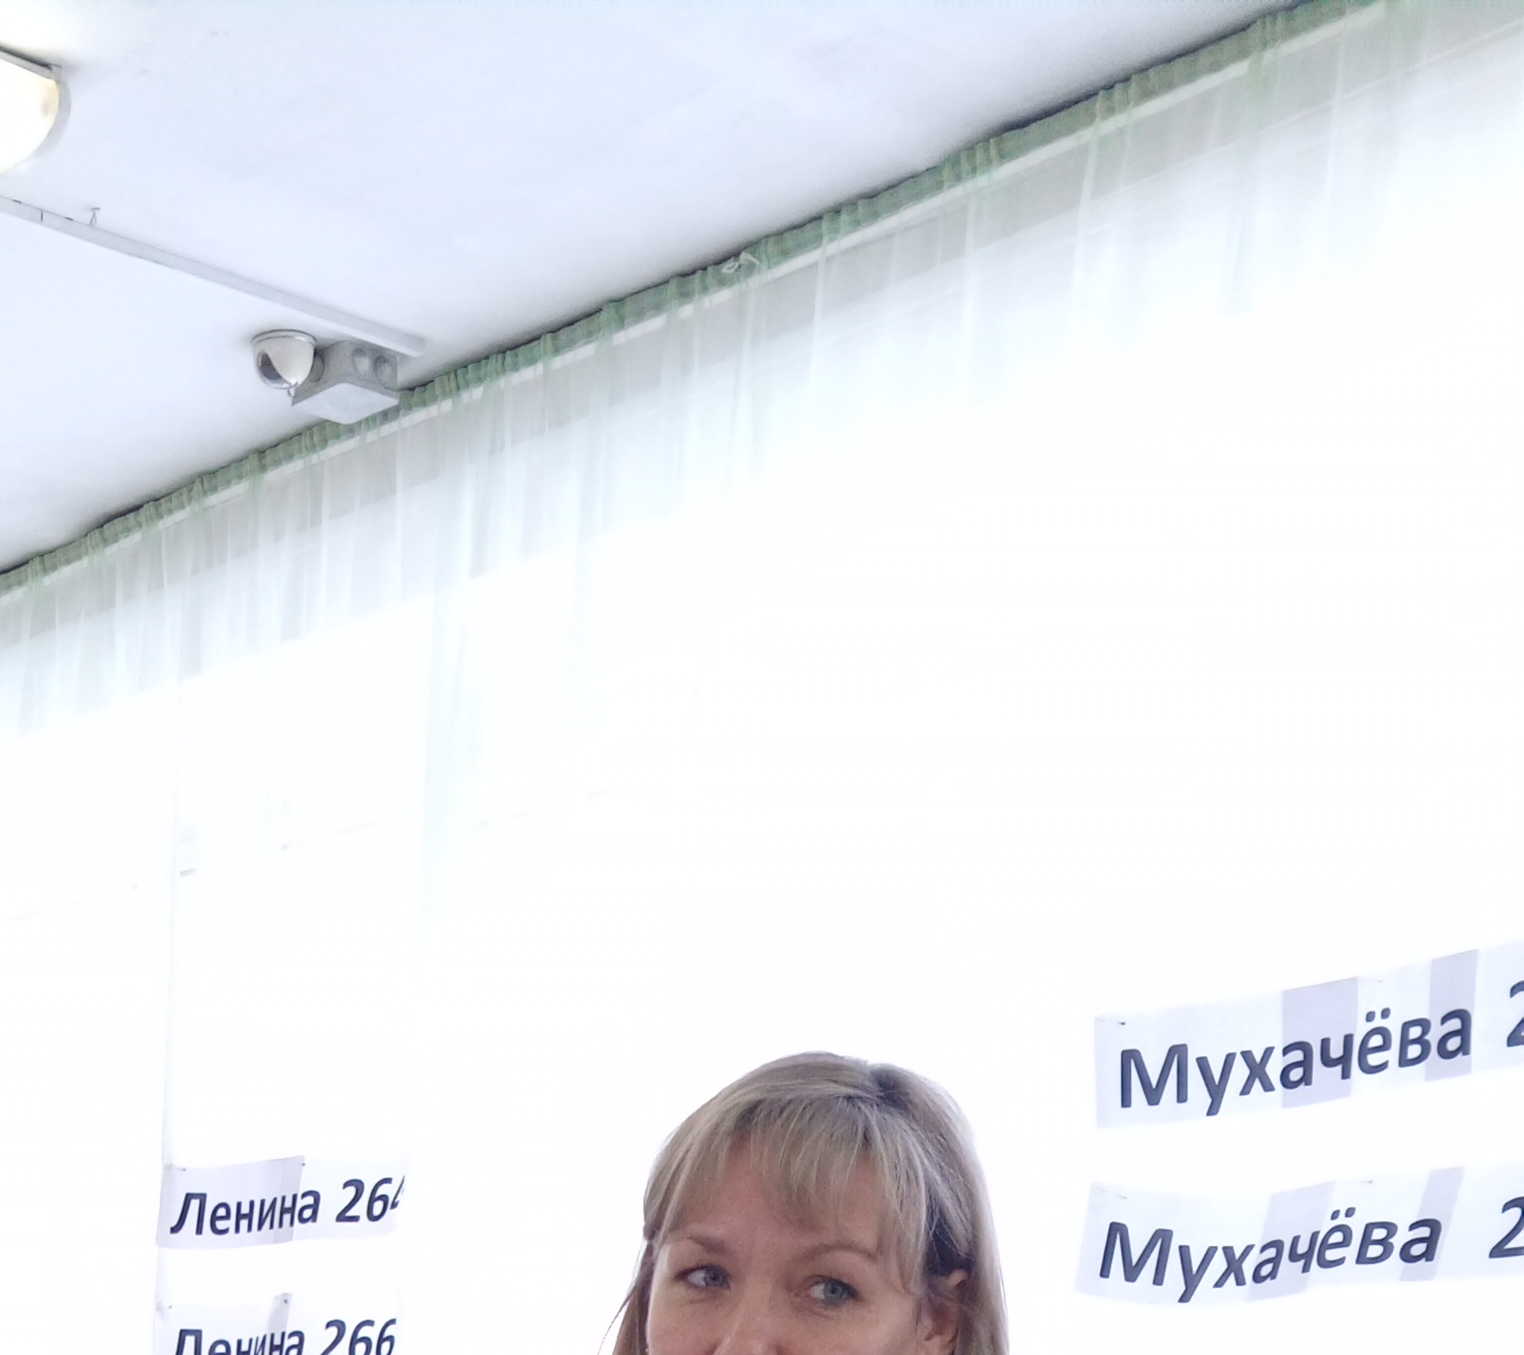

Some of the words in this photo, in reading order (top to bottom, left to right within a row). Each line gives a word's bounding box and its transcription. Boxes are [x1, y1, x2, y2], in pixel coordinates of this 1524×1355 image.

[1120, 1007, 1472, 1117] Мухачёва
[169, 1190, 321, 1236] Ленина
[1099, 1207, 1442, 1303] Мухачёва
